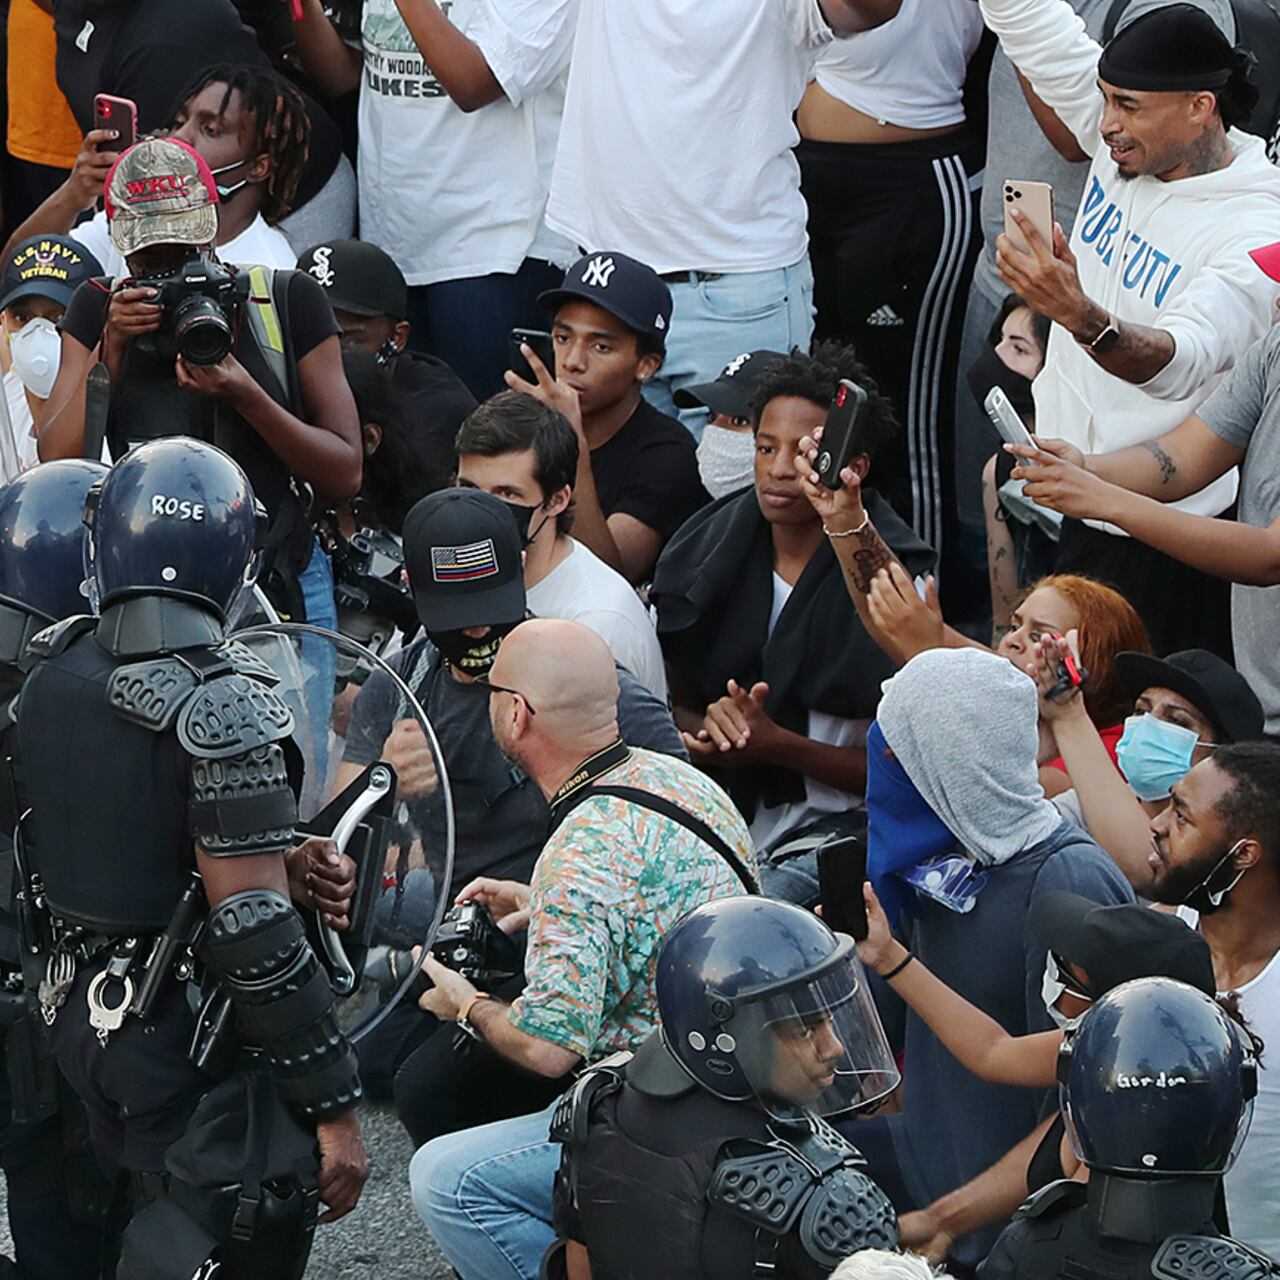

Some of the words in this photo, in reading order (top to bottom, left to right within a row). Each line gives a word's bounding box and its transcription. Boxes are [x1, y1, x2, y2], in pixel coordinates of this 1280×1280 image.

[126, 173, 192, 196] WKU
[40, 241, 81, 265] NAVY
[20, 267, 68, 280] VETERAN
[151, 494, 204, 521] ROSE
[557, 769, 590, 797] Nikon
